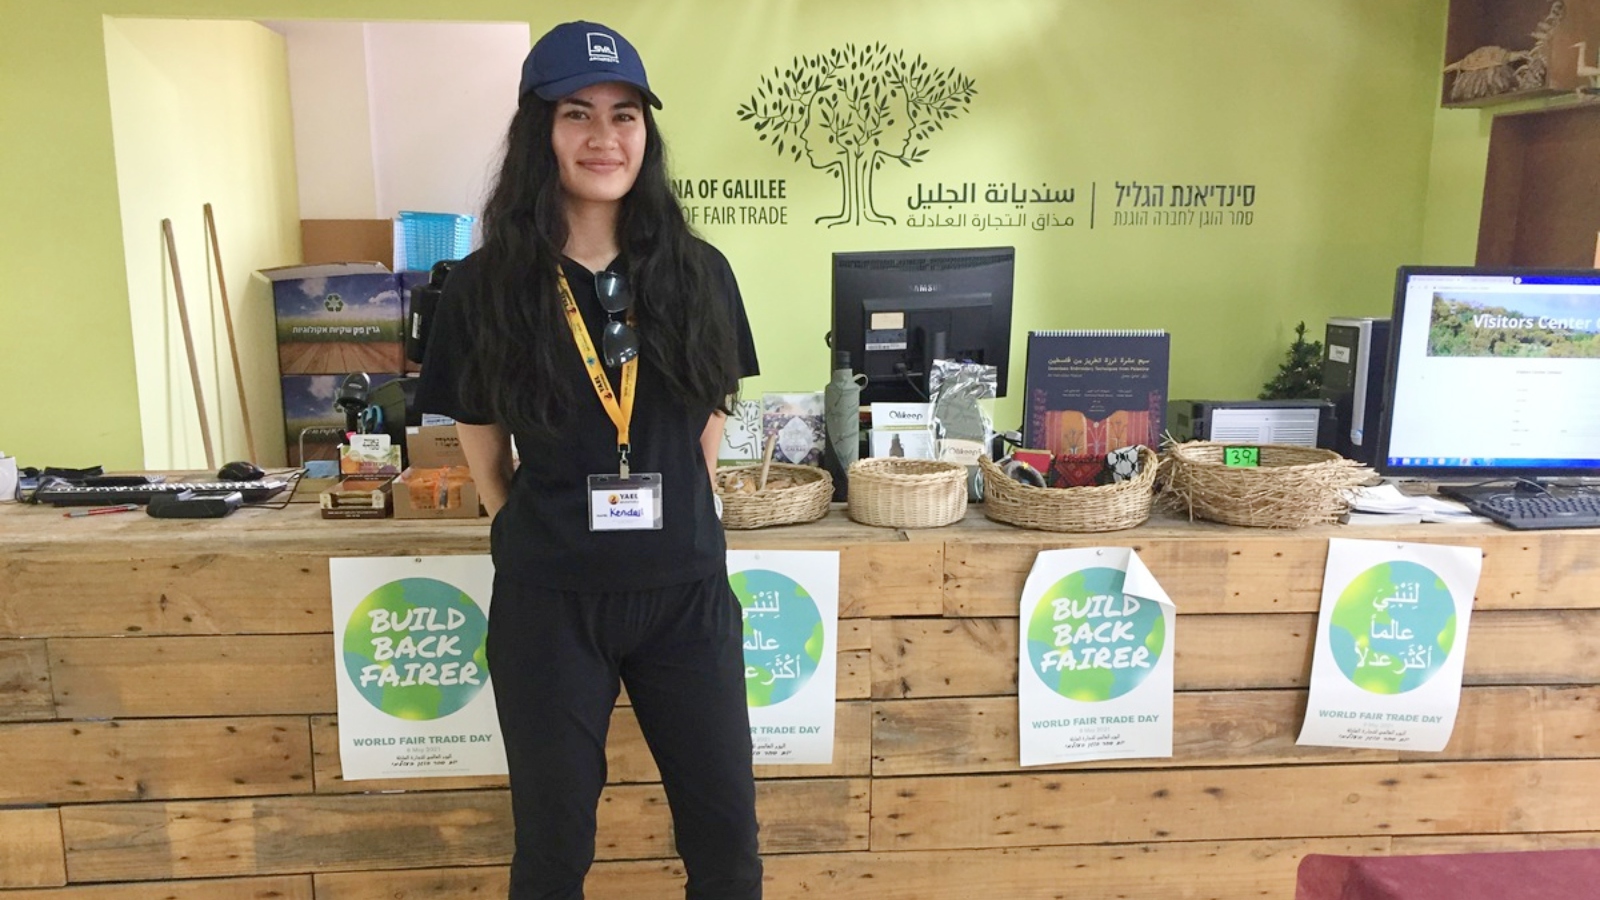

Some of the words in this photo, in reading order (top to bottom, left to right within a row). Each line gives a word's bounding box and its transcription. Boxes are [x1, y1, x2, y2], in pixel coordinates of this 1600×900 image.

[671, 179, 694, 199] NA
[698, 179, 718, 199] OF
[722, 179, 786, 199] GALILEE
[907, 182, 976, 210] الجليل
[984, 182, 1075, 210] سنديانة
[1114, 180, 1164, 207] הגליל
[1169, 184, 1256, 207] סינדיאנת
[703, 205, 736, 225] FAIR
[739, 205, 788, 225] TRADE
[906, 213, 967, 228] العادلة
[971, 212, 1027, 232] التجارة
[1031, 212, 1075, 231] مذاق
[1113, 210, 1149, 226] הוגנת
[1152, 208, 1196, 226] לחברה
[1198, 210, 1224, 228] הוגן
[1228, 210, 1254, 226] סחר
[1472, 313, 1534, 329] Visitors
[1538, 315, 1592, 330] Center
[1051, 595, 1141, 622] BUILD
[368, 606, 466, 633] BUILD
[743, 629, 780, 651] عالم
[1052, 620, 1135, 647] BACK
[371, 635, 462, 661] BACK
[1040, 645, 1151, 673] FAIRER
[360, 661, 481, 688] FAIRER
[1031, 718, 1071, 729] WORLD
[1072, 717, 1097, 726] FAIR
[1099, 715, 1135, 725] TRADE
[1137, 714, 1160, 723] DAY
[1319, 709, 1357, 719] WORLD
[1359, 711, 1384, 720] FAIR
[1386, 713, 1420, 723] TRADE
[1421, 715, 1443, 724] DAY
[760, 726, 796, 734] TRADE
[798, 725, 821, 734] DAY
[353, 737, 396, 747] WORLD
[399, 736, 426, 745] FAIR
[428, 735, 467, 744] TRADE
[469, 733, 493, 743] DAY
